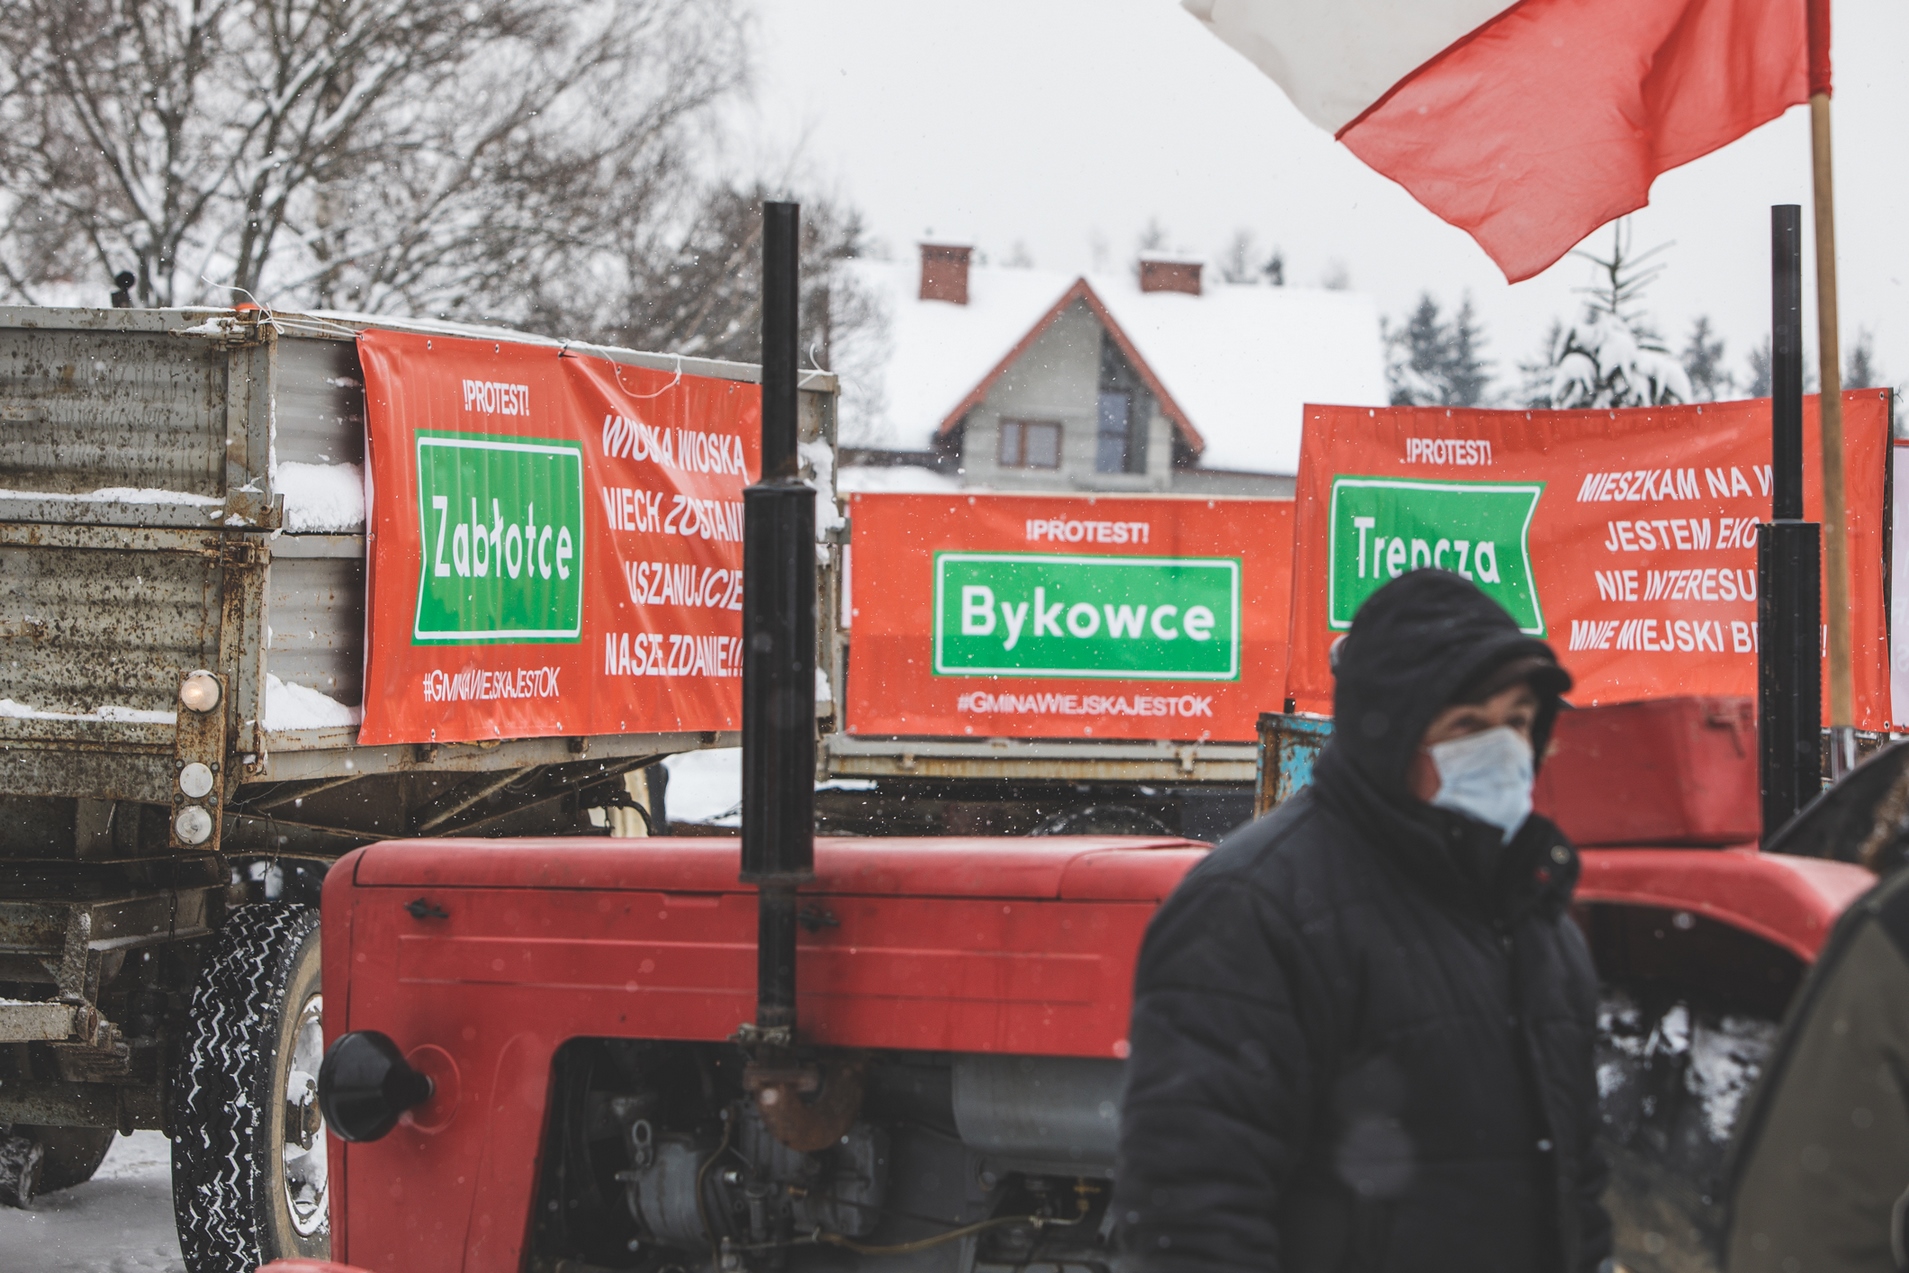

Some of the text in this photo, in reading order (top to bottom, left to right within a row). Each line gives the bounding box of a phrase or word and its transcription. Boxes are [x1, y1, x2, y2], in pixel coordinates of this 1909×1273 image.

[462, 379, 530, 417] !PROTEST!
[1406, 438, 1492, 466] !PROTEST!
[1577, 468, 1701, 502] MIESZKAM
[1704, 466, 1752, 498] NA
[602, 486, 744, 542] NIECH ZOSTANI
[1025, 519, 1150, 544] !PROTEST!
[432, 495, 573, 581] Zabłotce
[1354, 516, 1501, 584] Trepcza
[1604, 518, 1711, 551] JESTEM
[625, 560, 743, 611] USZANUJCIE
[1594, 568, 1757, 602] NIE INTERESU
[961, 585, 1216, 652] Bykowce
[1568, 619, 1620, 651] MNIE
[1616, 618, 1724, 652] MIEJSKI
[605, 632, 667, 676] NASZE
[957, 691, 1213, 718] #GMINAWIEJSKAJESTOK
